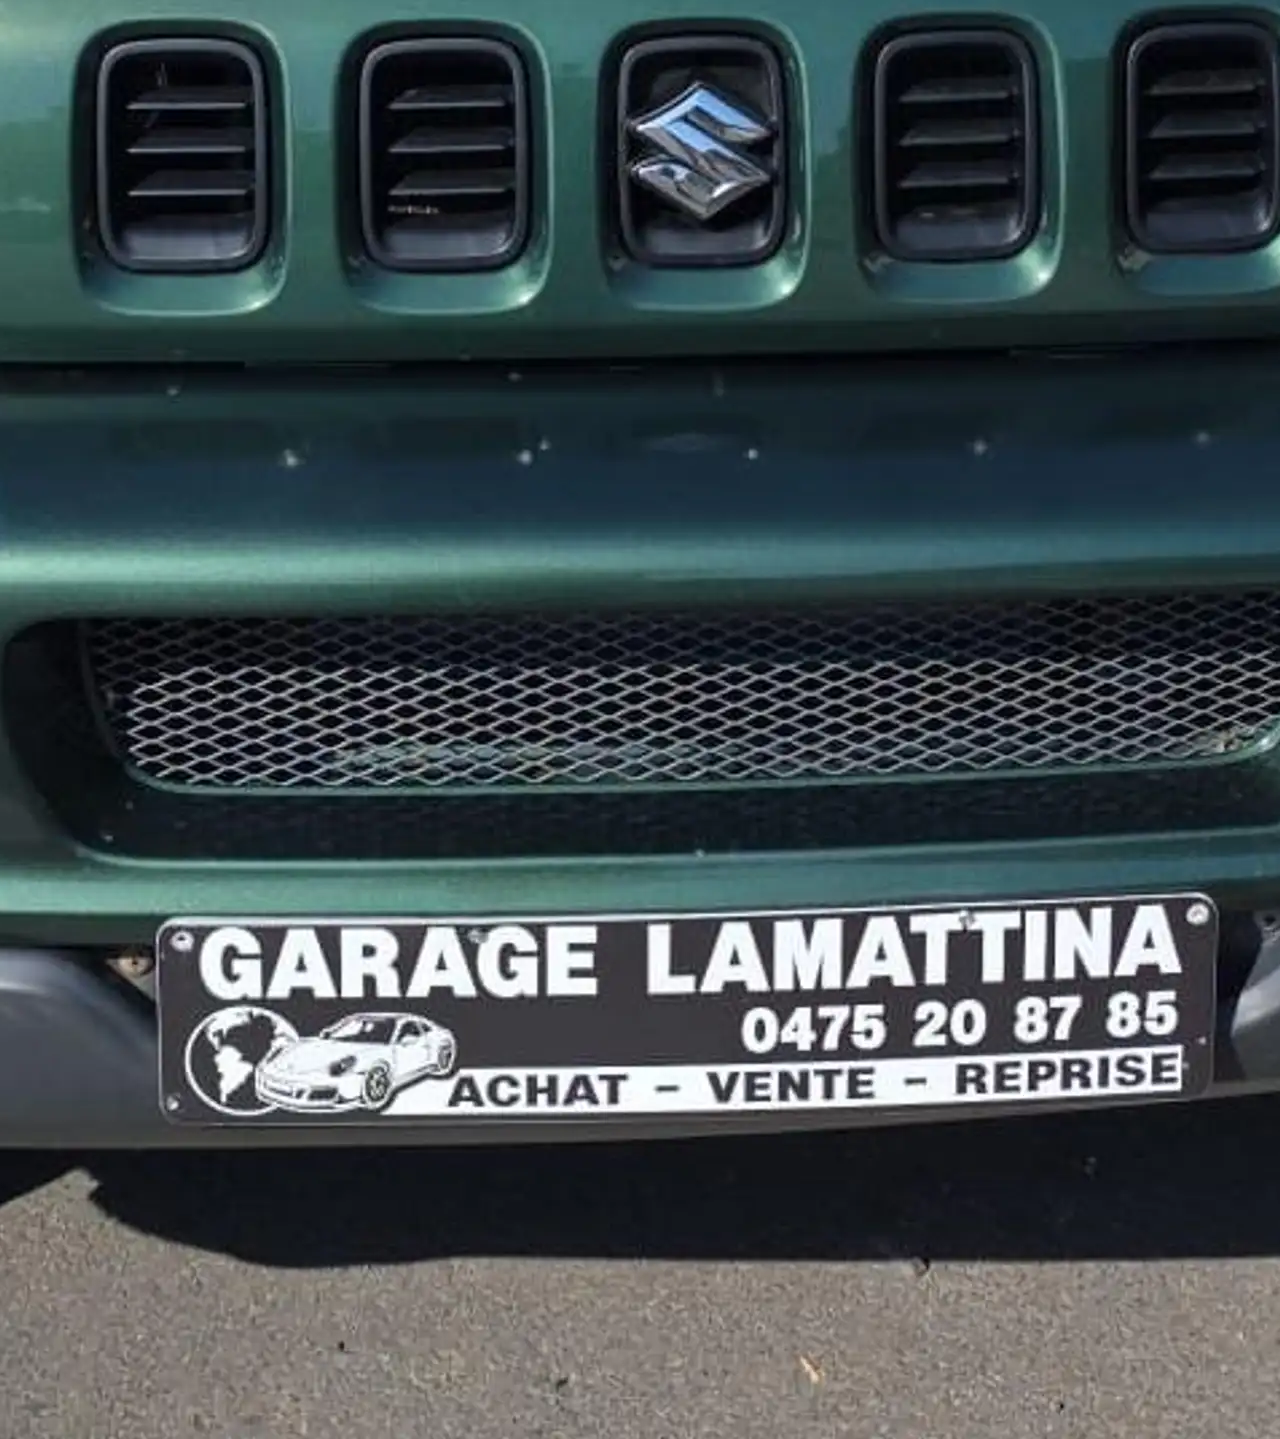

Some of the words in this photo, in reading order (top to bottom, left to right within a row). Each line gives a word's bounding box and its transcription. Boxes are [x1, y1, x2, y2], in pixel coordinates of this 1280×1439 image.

[198, 924, 598, 998] GARAGE
[647, 905, 1182, 994] LAMATTINA
[741, 1004, 887, 1054] 0475
[912, 1000, 986, 1046] 20
[1013, 996, 1082, 1042] 87
[1105, 990, 1178, 1038] 85
[447, 1073, 629, 1108] ACHAT
[706, 1067, 876, 1103] VENTE
[955, 1053, 1181, 1096] REPRISE
